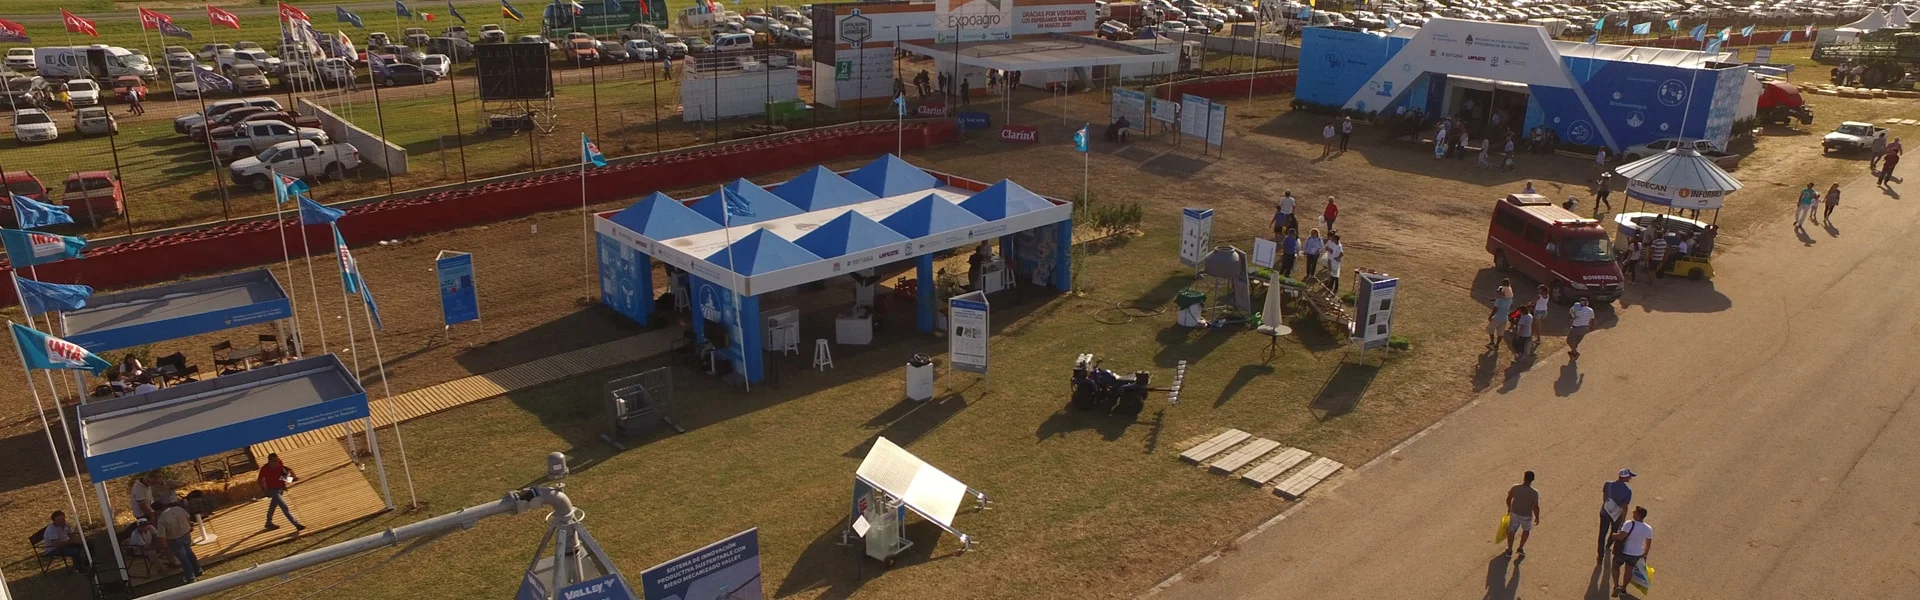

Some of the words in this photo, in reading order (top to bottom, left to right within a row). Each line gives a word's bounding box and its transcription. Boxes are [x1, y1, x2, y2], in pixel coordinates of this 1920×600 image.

[948, 14, 1000, 29] Expoagro
[48, 339, 82, 361] INTA
[657, 566, 695, 585] PRODUCTIVA
[695, 551, 734, 570] SUSTENTABLE
[734, 545, 747, 555] CON
[666, 560, 692, 574] SISTEMA
[693, 556, 700, 564] DE
[701, 542, 737, 560] INNOVACIÓN
[663, 579, 682, 590] RIEGO
[683, 562, 721, 583] MECANIZADO
[722, 554, 741, 566] VALLEY
[564, 582, 603, 600] VALLEY
